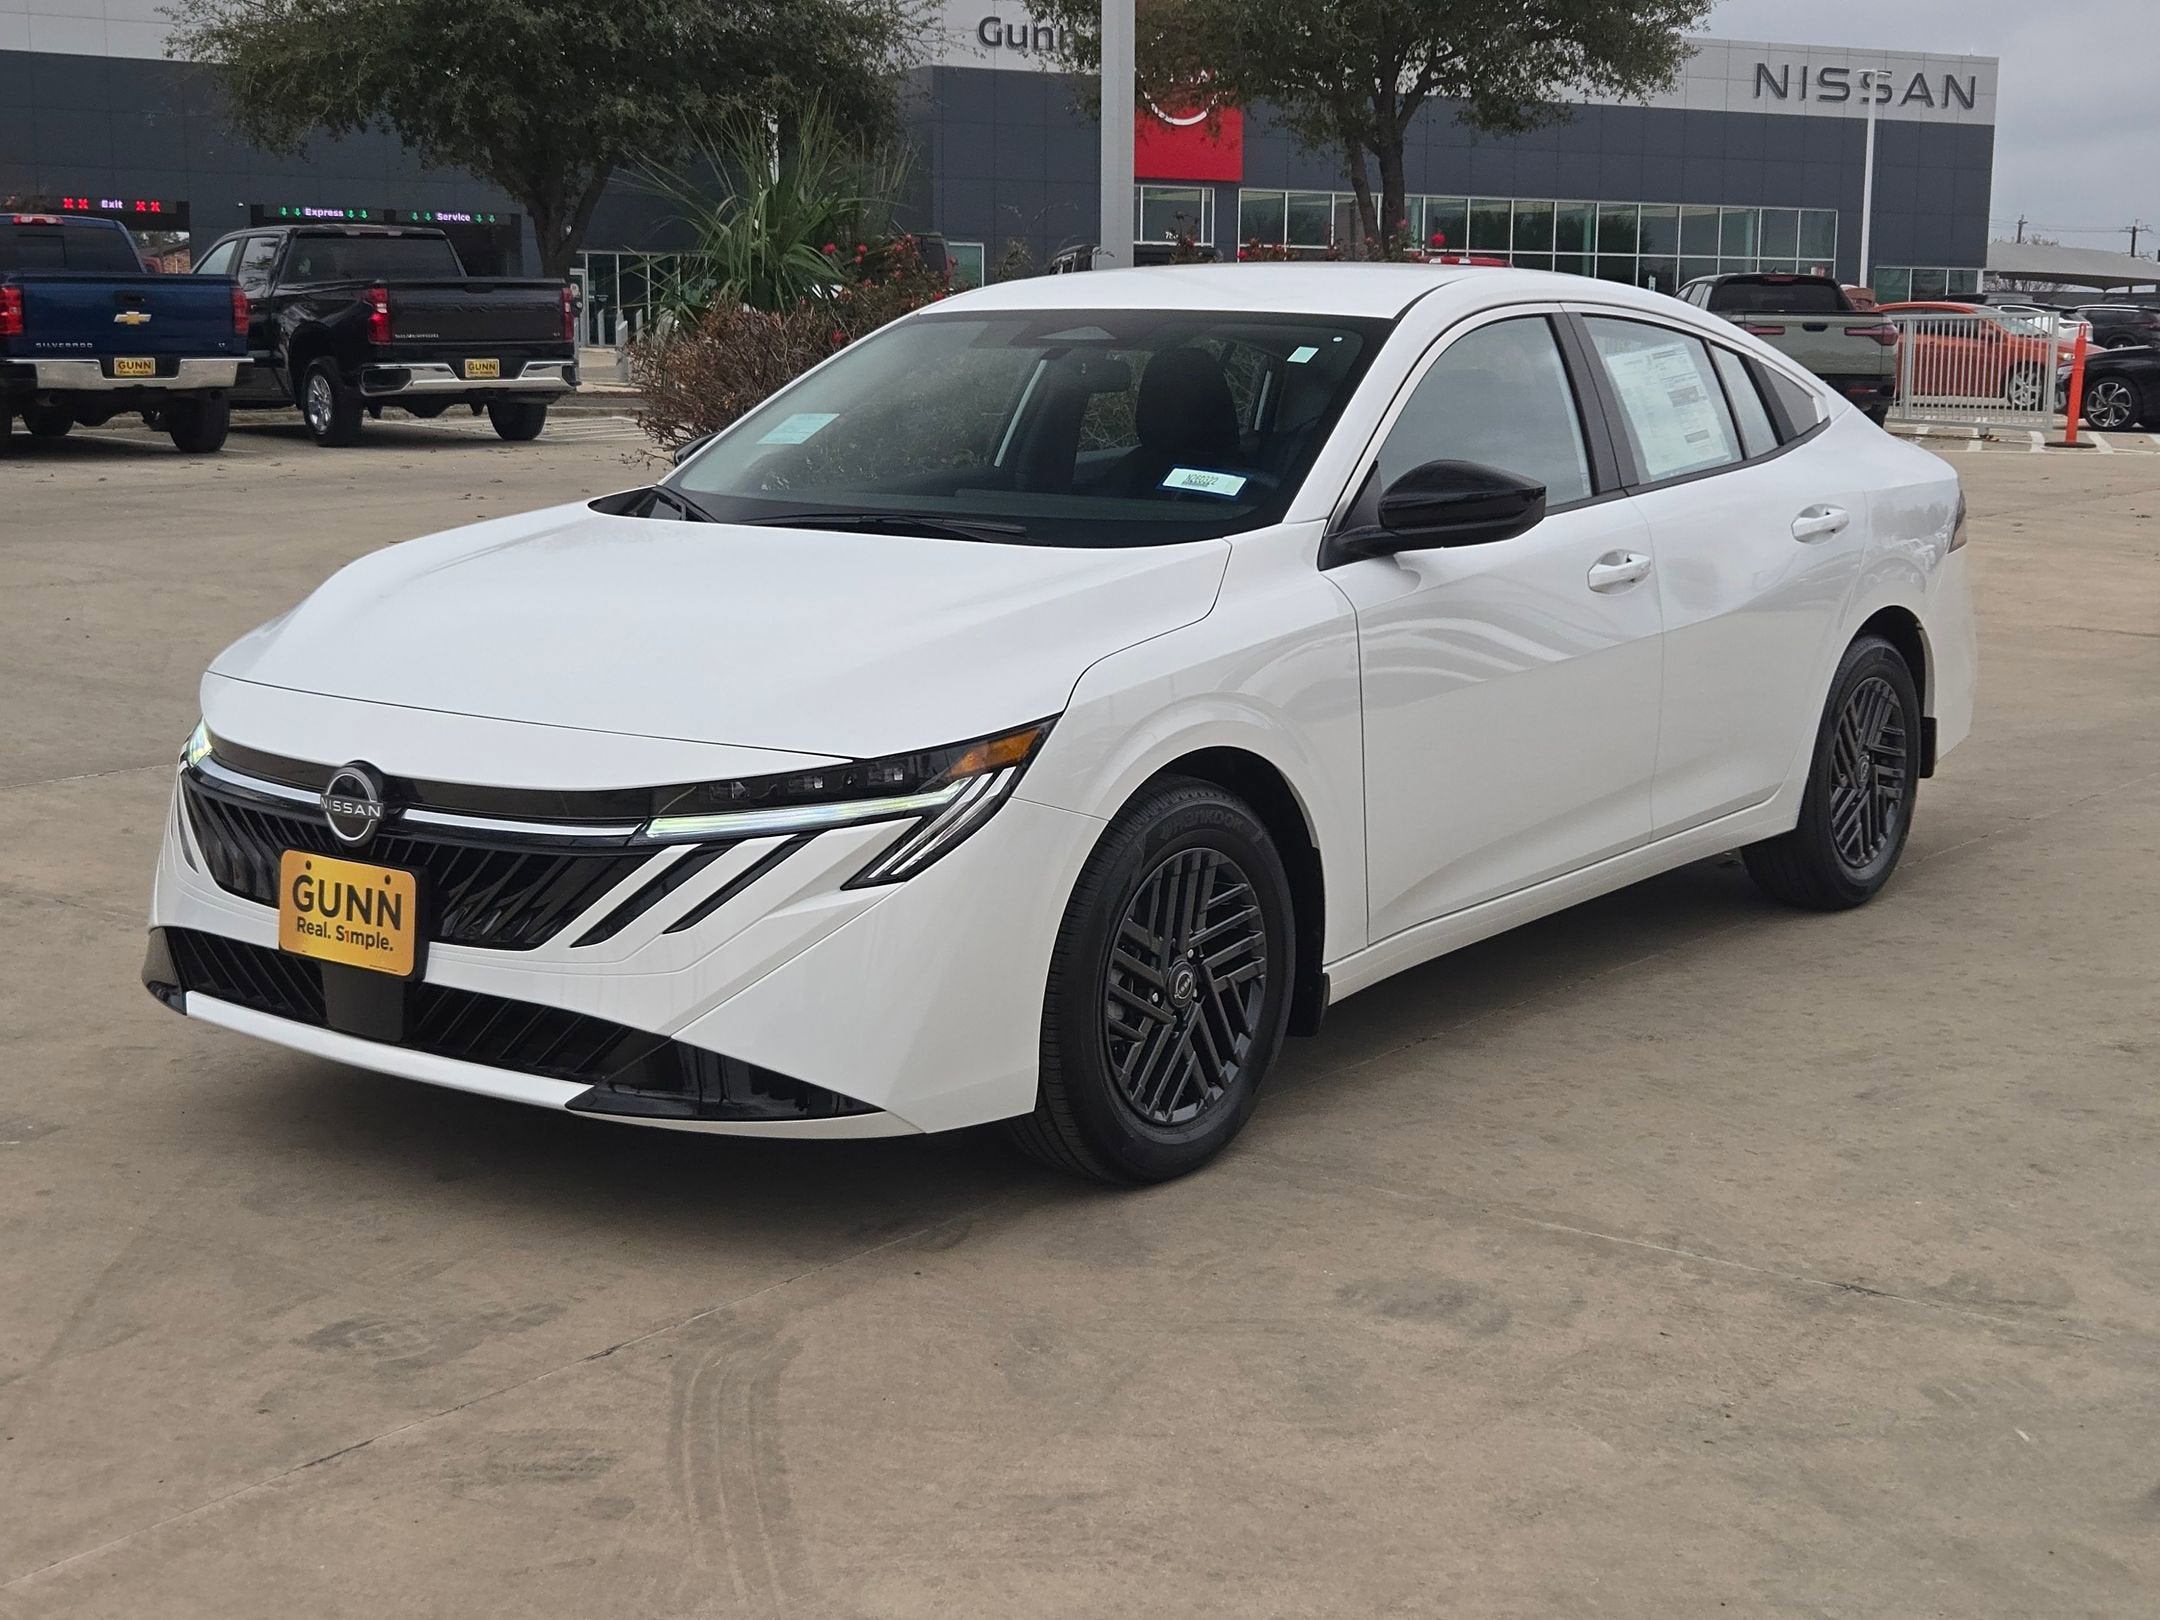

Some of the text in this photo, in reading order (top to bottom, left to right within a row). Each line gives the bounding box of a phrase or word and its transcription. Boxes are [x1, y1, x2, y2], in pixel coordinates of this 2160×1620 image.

[1754, 62, 1977, 109] NISSAN
[101, 200, 123, 209] Exit
[305, 207, 344, 218] Express
[437, 212, 471, 222] Service
[118, 361, 151, 370] GUNN
[468, 363, 496, 371] GUNN
[320, 796, 381, 818] NISSAN
[292, 874, 402, 931] GUNN
[296, 916, 331, 940] Real.
